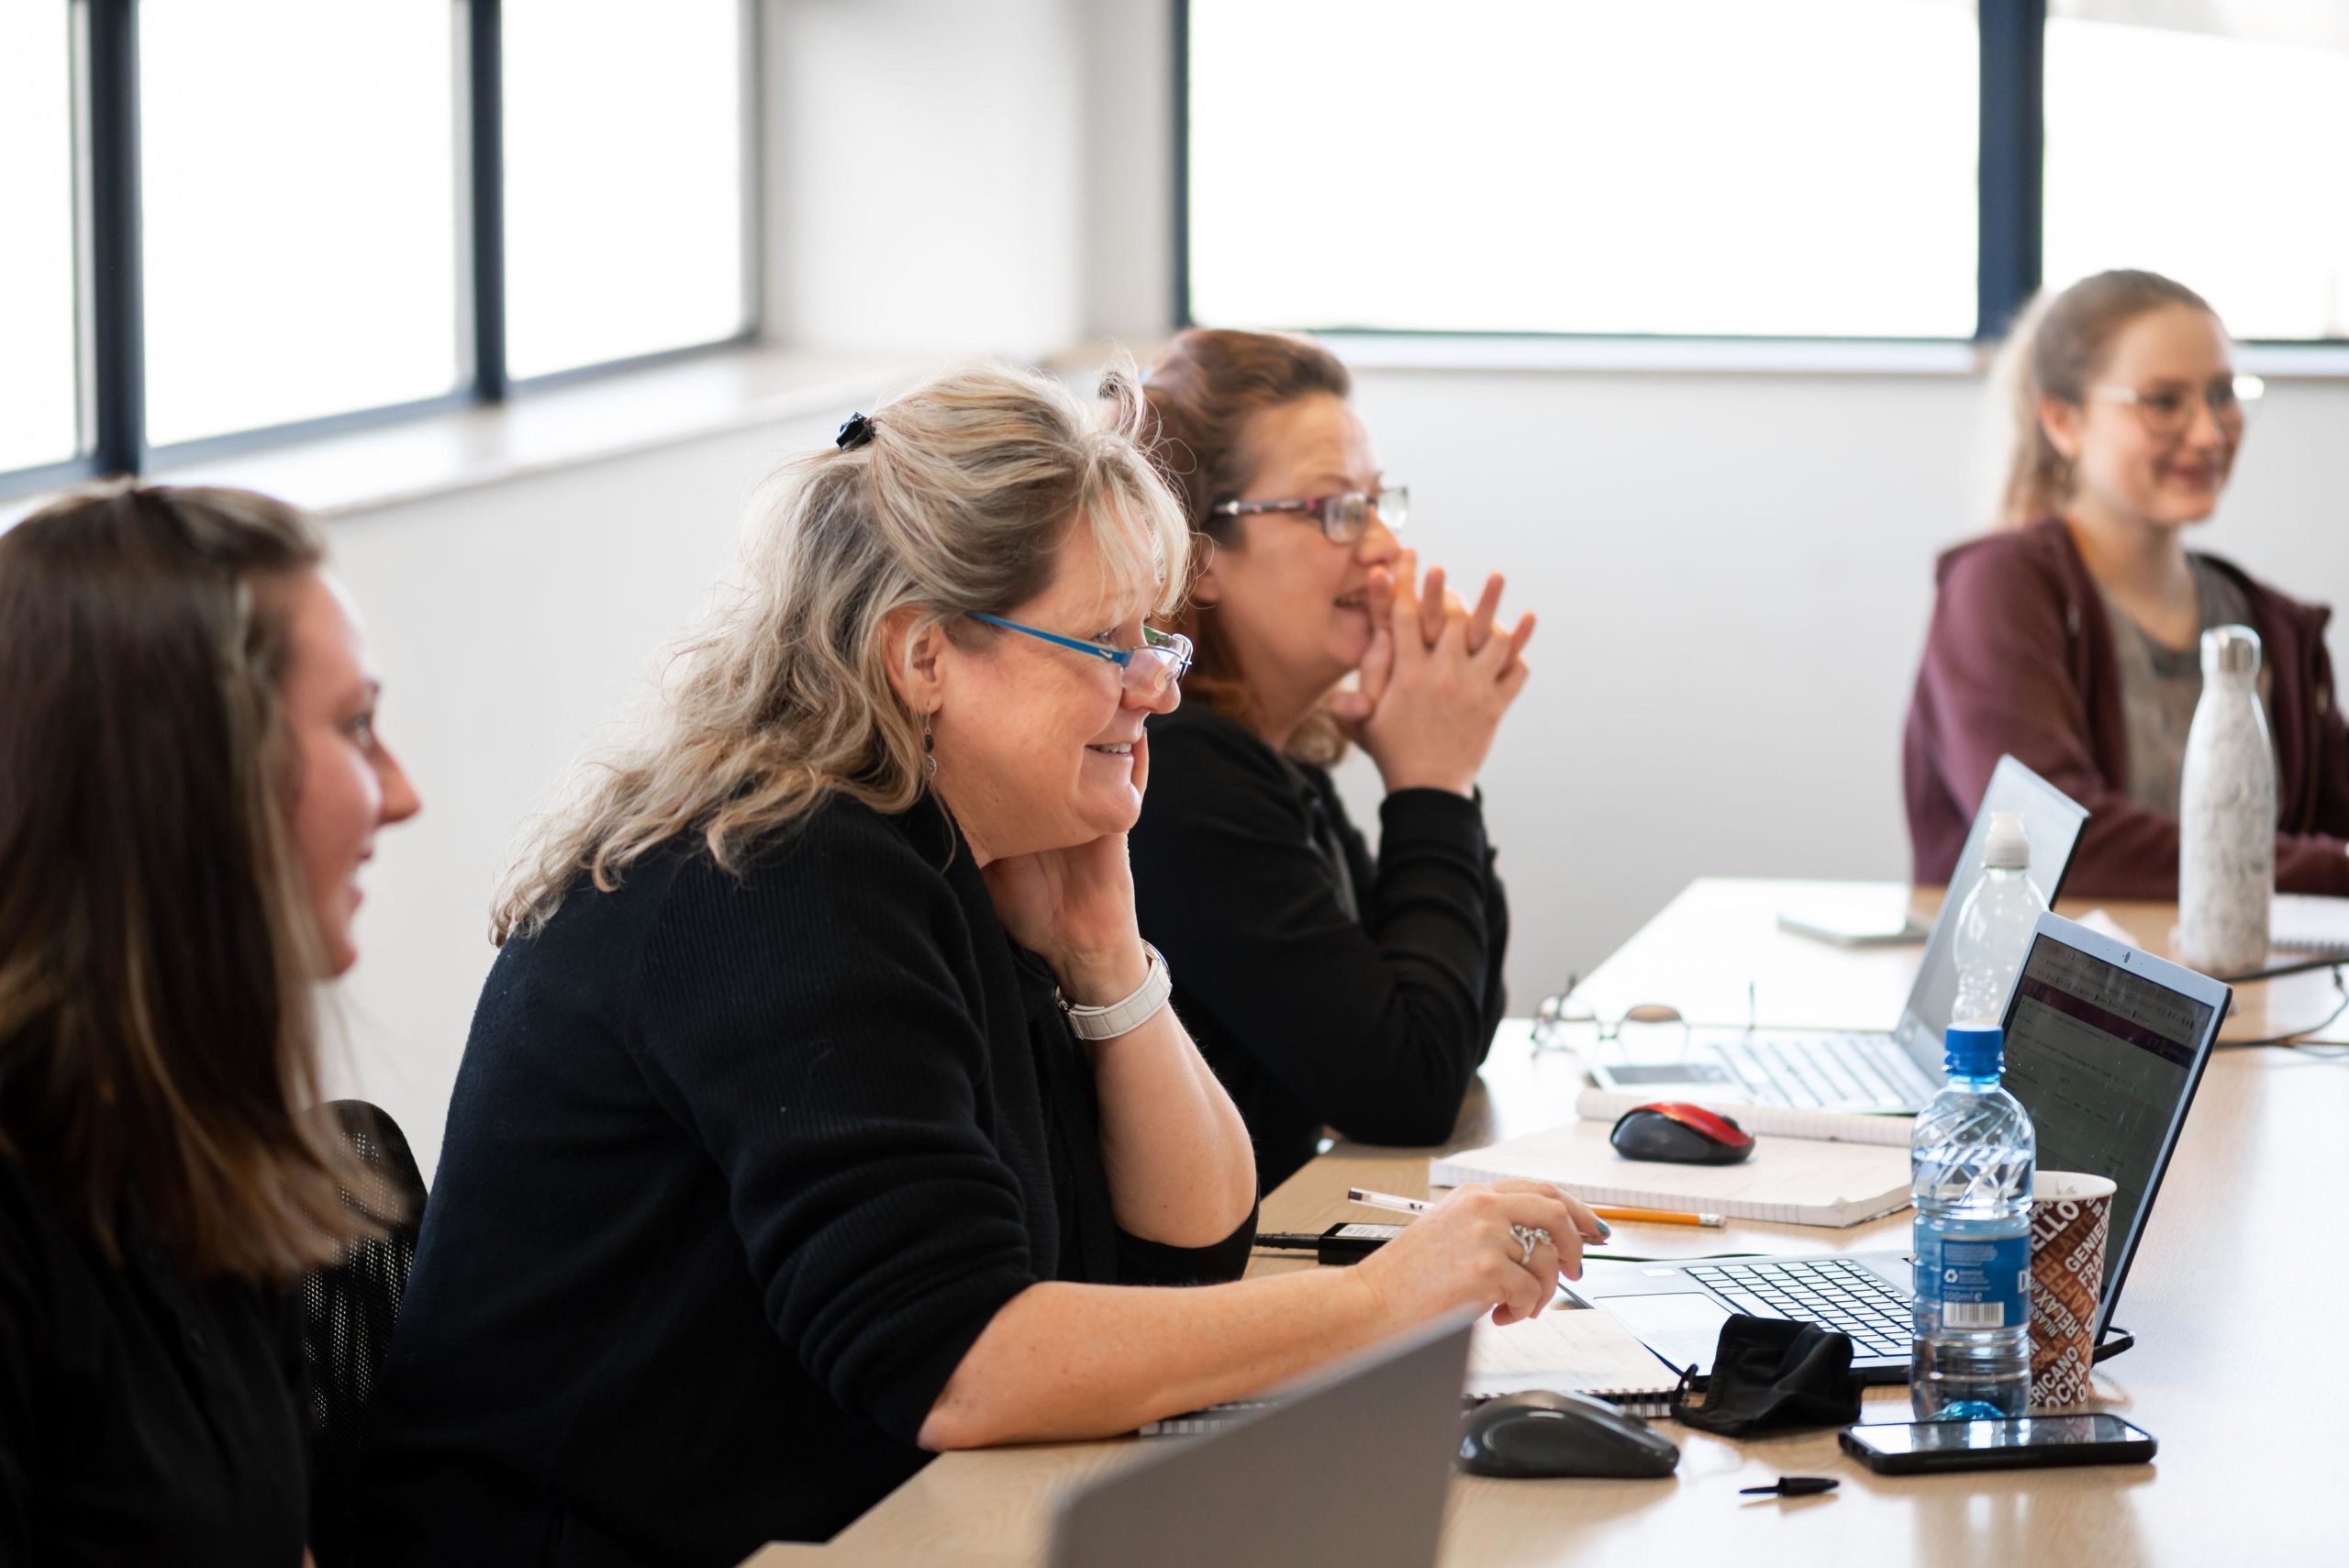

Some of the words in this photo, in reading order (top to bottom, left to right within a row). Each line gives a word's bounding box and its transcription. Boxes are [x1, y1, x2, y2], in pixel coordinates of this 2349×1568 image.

[2026, 1201, 2080, 1254] ELLO
[2017, 1269, 2032, 1293] D
[2031, 1251, 2093, 1321] KAFFEE
[2032, 1289, 2081, 1339] RELAX
